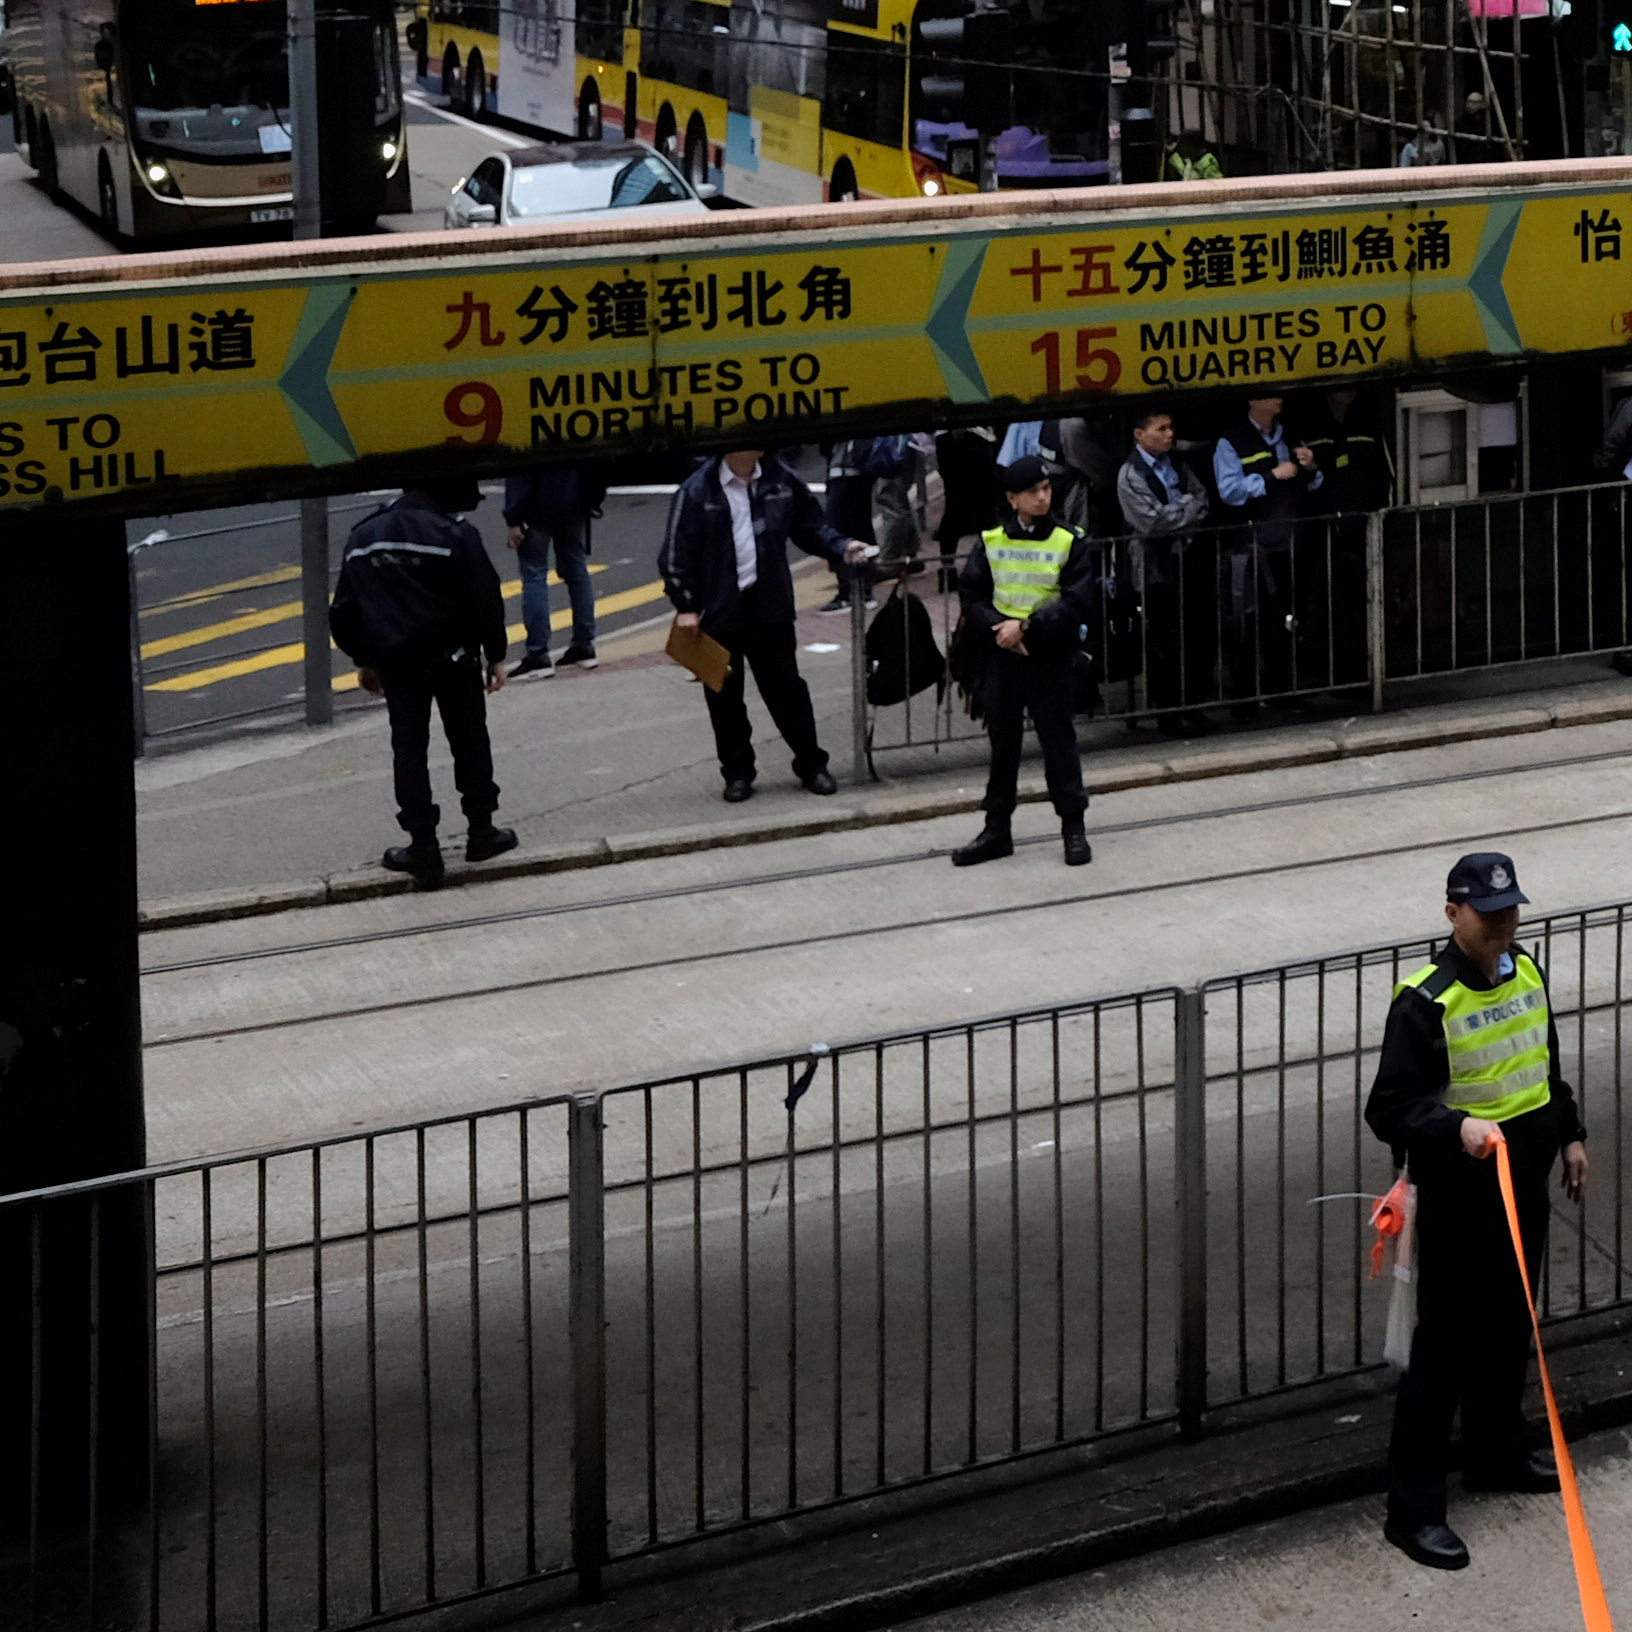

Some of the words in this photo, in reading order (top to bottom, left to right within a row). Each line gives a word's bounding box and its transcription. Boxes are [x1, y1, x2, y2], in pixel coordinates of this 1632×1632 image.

[1010, 220, 1451, 303] 十五分鐘到鰂魚涌
[444, 265, 852, 351] 九分鐘到北角
[1030, 326, 1122, 395] 15
[1140, 308, 1321, 351] MINUTES
[1335, 303, 1387, 333] TO
[1141, 343, 1303, 387] QUARRY
[1316, 336, 1387, 368] BAY
[46, 414, 121, 451] TO
[443, 381, 504, 459] 9
[530, 359, 743, 409] MINUTES
[759, 353, 821, 387] TO
[530, 401, 694, 447] NORTH
[714, 387, 850, 431] POINT
[69, 450, 181, 490] HILL
[1483, 998, 1522, 1024] POLICE
